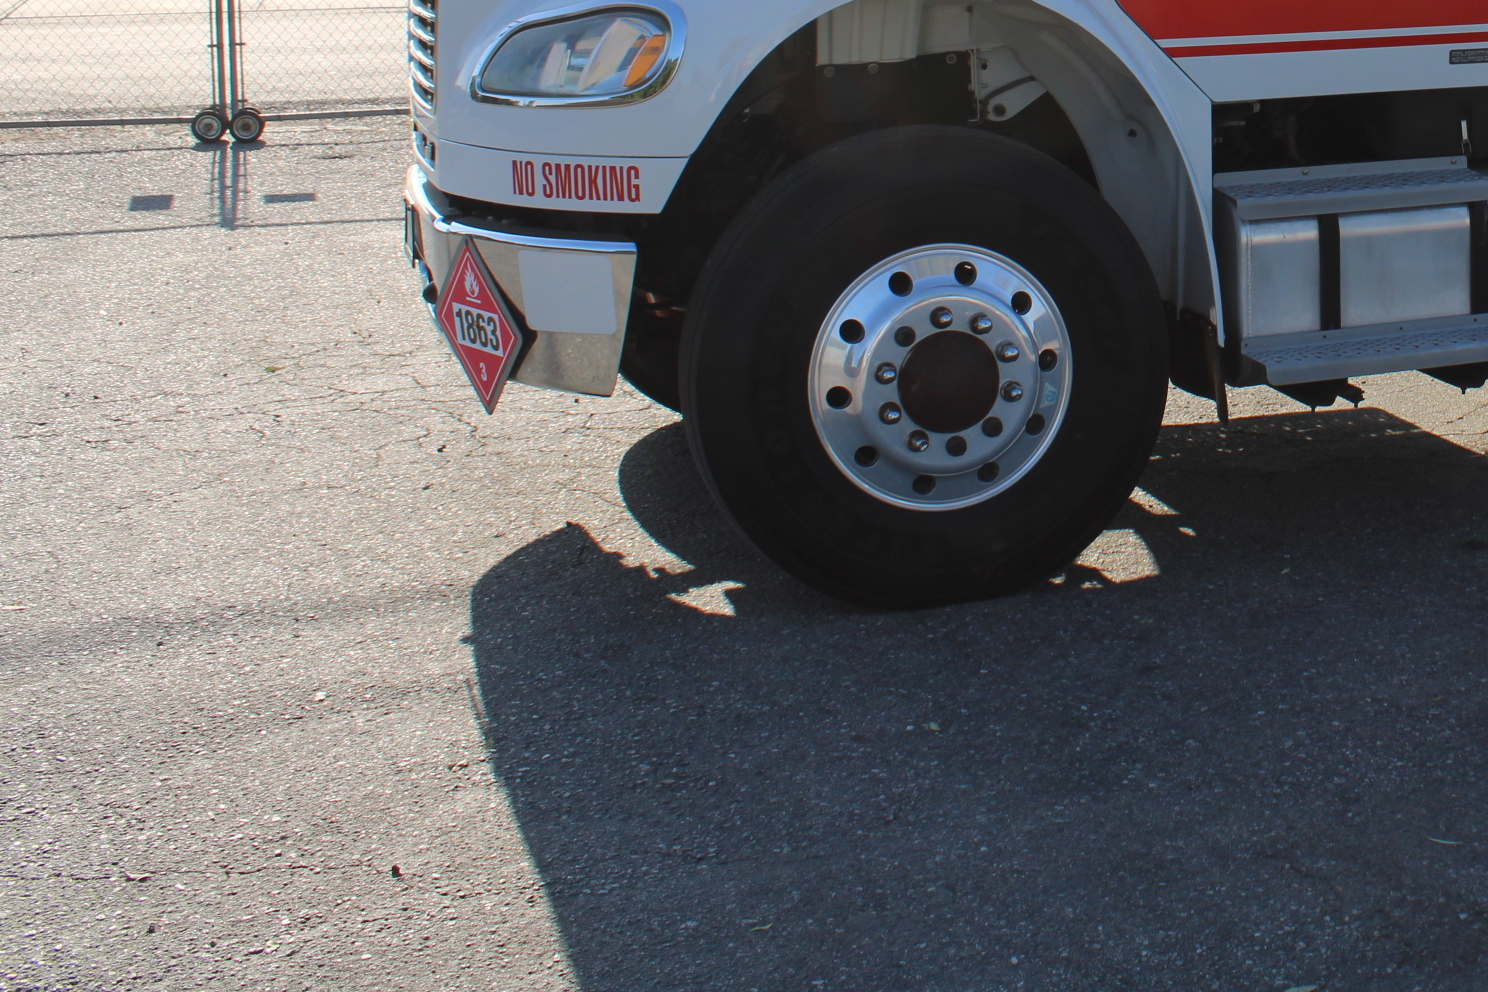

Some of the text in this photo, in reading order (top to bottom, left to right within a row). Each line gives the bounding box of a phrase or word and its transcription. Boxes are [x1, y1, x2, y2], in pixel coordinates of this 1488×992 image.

[511, 159, 642, 203] NO SMOKING
[455, 308, 500, 352] 1863
[479, 361, 488, 382] 3
